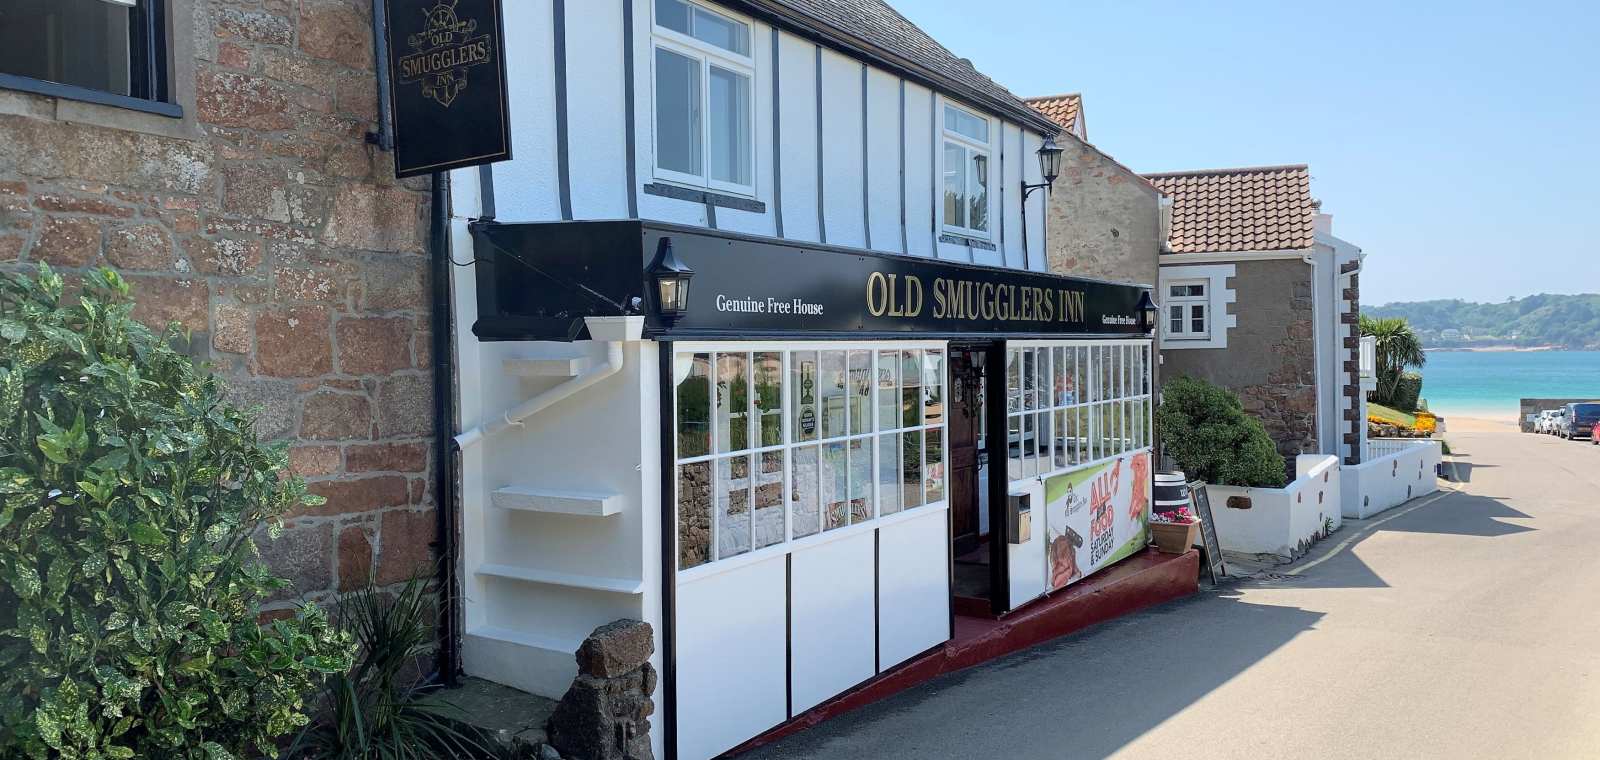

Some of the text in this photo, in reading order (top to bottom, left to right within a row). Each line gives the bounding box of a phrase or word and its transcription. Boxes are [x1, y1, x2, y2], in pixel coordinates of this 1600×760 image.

[431, 31, 453, 46] OLD
[402, 41, 486, 78] SMUGGLERS
[436, 69, 454, 86] INN
[716, 294, 824, 315] Genuine Free House
[866, 271, 1085, 323] OLD SMUGGLERS INN
[1089, 472, 1111, 515] ALL
[1090, 504, 1114, 541] FOOD
[1090, 527, 1114, 554] SATURDAY
[1090, 539, 1114, 566] & SUNDAY
